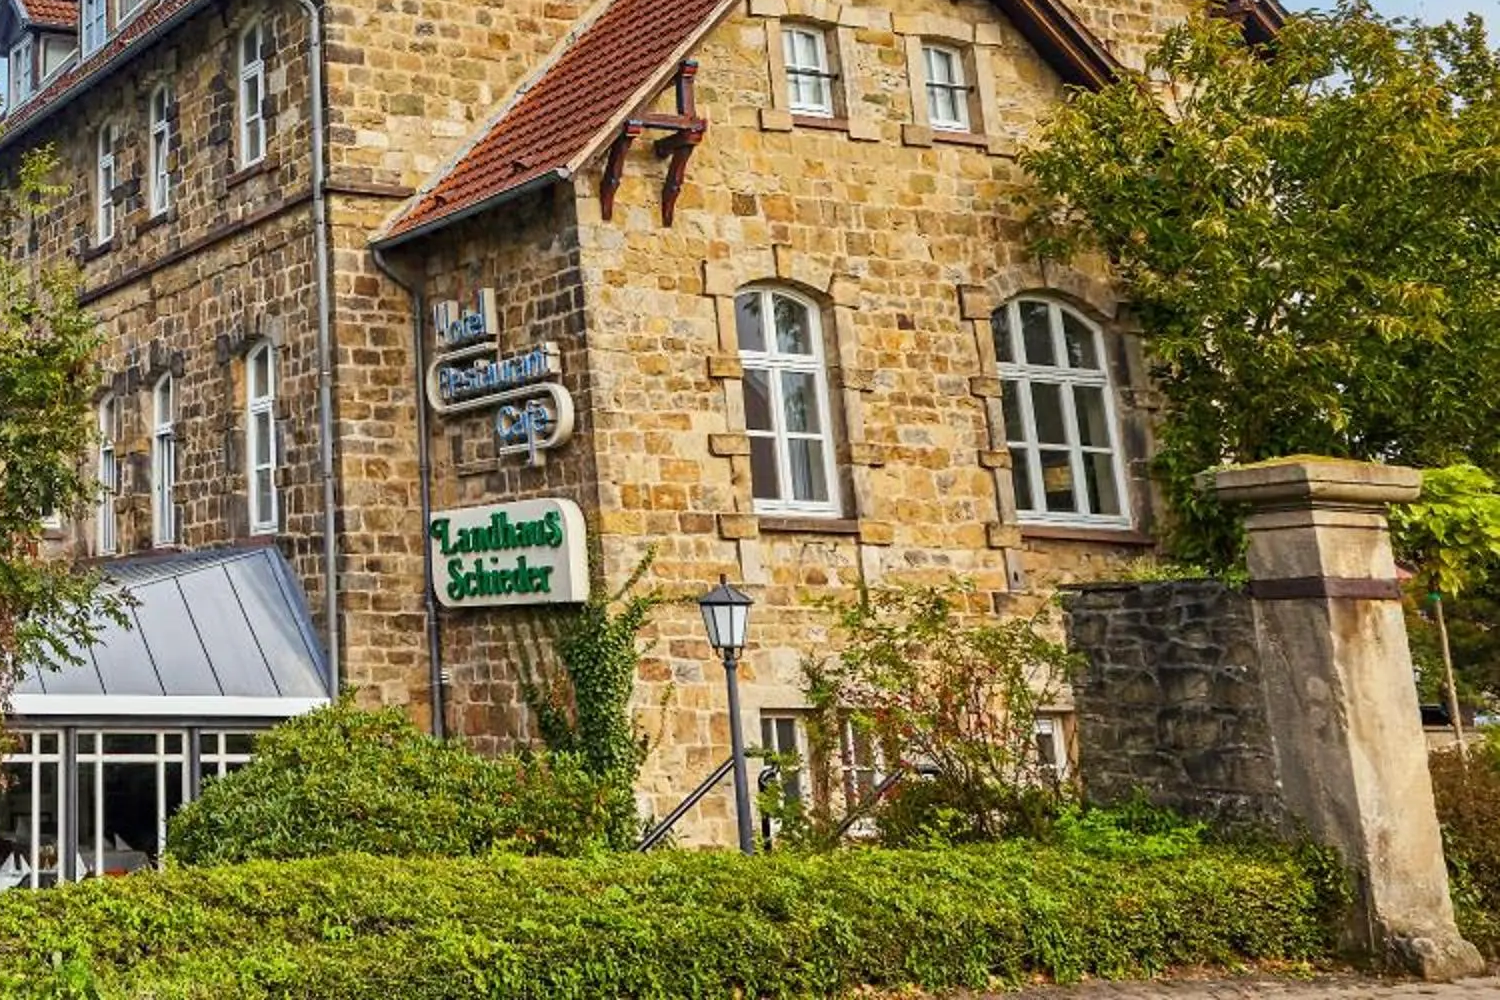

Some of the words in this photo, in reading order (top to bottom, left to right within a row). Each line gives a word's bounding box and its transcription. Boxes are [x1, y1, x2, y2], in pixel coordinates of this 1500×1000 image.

[433, 287, 495, 345] Hotel
[439, 342, 561, 399] Restaurant
[431, 511, 563, 555] Landhaus
[447, 556, 554, 601] Schieder
